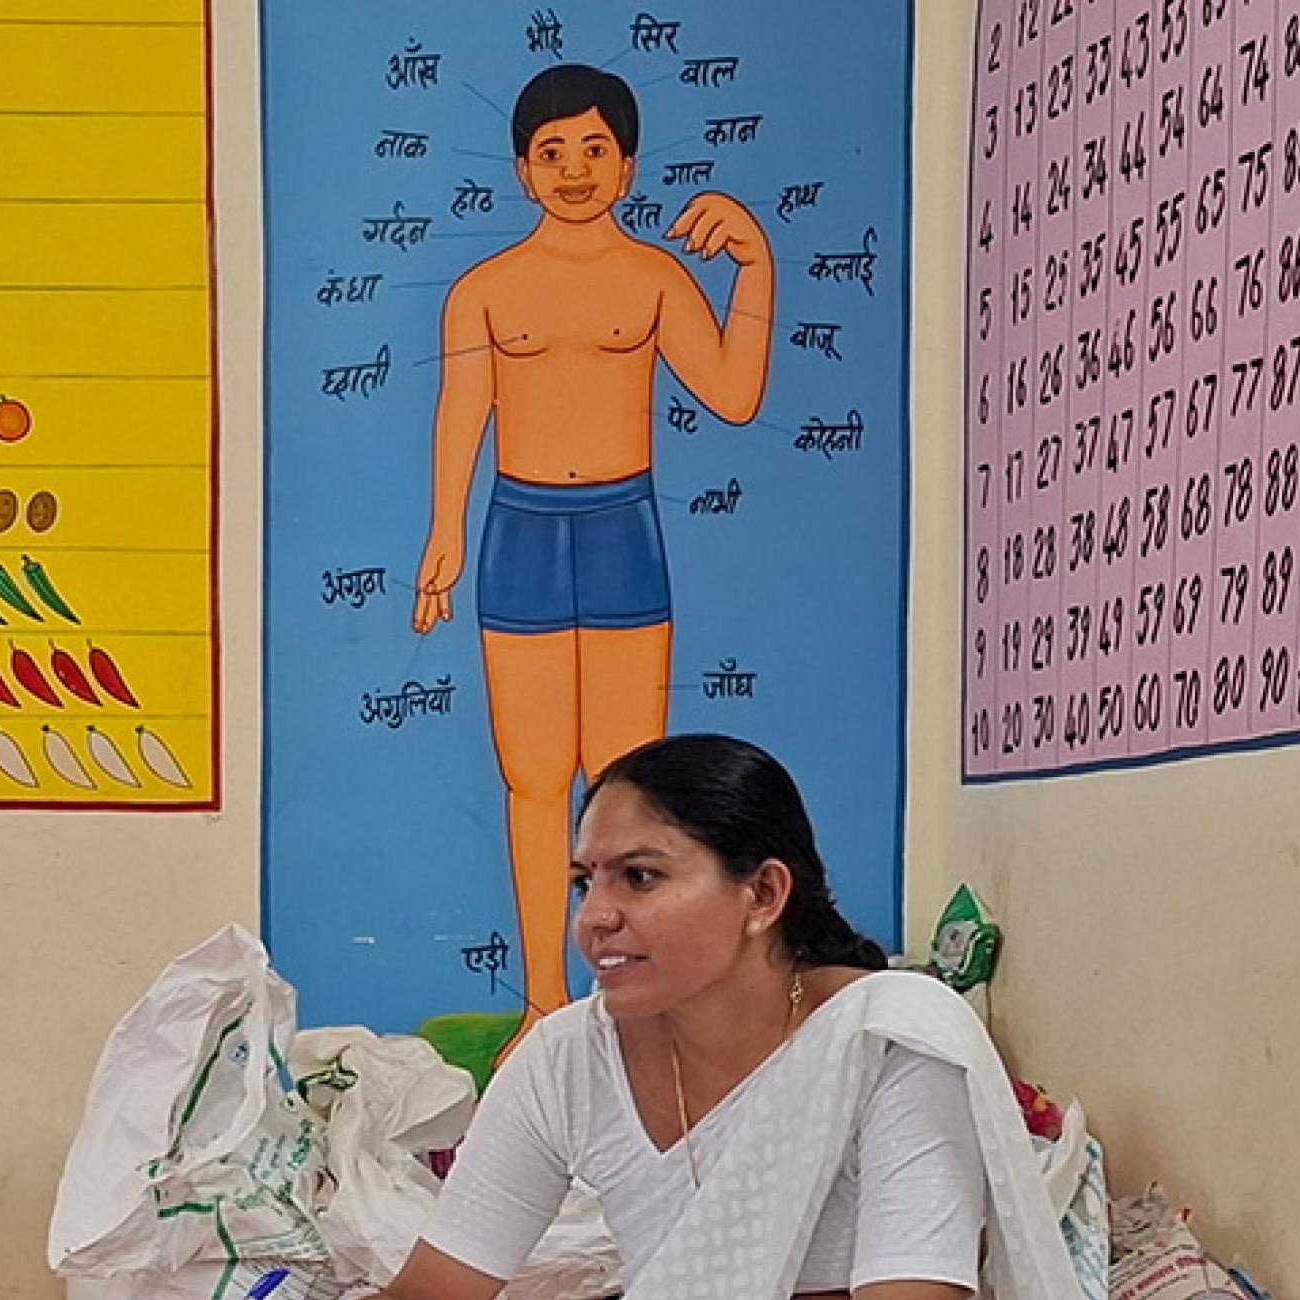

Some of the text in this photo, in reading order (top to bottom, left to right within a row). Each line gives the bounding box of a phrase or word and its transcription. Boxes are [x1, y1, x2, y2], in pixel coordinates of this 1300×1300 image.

[630, 13, 681, 54] सिर
[988, 22, 1000, 73] 2
[1017, 0, 1038, 47] 12
[386, 37, 441, 90] आँख
[680, 57, 739, 87] बाल
[984, 105, 998, 160] 3
[1015, 81, 1037, 137] 13
[1048, 55, 1073, 119] 23
[1085, 35, 1111, 104] 33
[1121, 12, 1149, 88] 43
[374, 130, 429, 158] नाक
[704, 114, 763, 148] कान
[979, 200, 994, 252] 4
[1013, 182, 1032, 235] 14
[1047, 155, 1071, 215] 24
[1083, 137, 1107, 199] 34
[1120, 111, 1146, 183] 44
[1160, 85, 1185, 157] 54
[1199, 64, 1223, 128] 64
[1239, 34, 1269, 106] 74
[662, 160, 714, 185] गाल
[363, 200, 432, 252] गर्दन
[621, 190, 663, 233] दाँत
[777, 181, 824, 223] हाथ
[808, 226, 877, 296] कलाई
[980, 288, 992, 340] 5
[1012, 268, 1032, 326] 15
[1045, 250, 1069, 310] 25
[1081, 233, 1106, 297] 35
[1116, 217, 1143, 286] 45
[1154, 192, 1185, 267] 55
[1196, 168, 1225, 234] 65
[1238, 142, 1272, 213] 75
[317, 268, 383, 307] कंधा
[979, 375, 989, 424] 6
[1008, 357, 1027, 415] 16
[1040, 345, 1064, 405] 26
[1076, 328, 1100, 389] 36
[1108, 310, 1135, 378] 46
[1149, 291, 1174, 362] 56
[1192, 276, 1217, 342] 66
[1235, 248, 1263, 318] 76
[322, 343, 390, 401] छाती
[667, 395, 698, 434] पेट
[793, 408, 864, 460] कोहनी
[978, 464, 992, 508] 7
[1006, 451, 1023, 504] 17
[1037, 435, 1062, 490] 27
[1074, 416, 1100, 475] 37
[1107, 409, 1133, 473] 47
[1146, 389, 1174, 459] 57
[1187, 374, 1217, 438] 67
[1232, 358, 1263, 417] 77
[977, 443, 1298, 604] 8 18 28 38 48 58 68 78 88
[975, 545, 1293, 679] 9 19 29 39 49 59 69 79 89
[972, 646, 1289, 757] 10 20 30 40 50 60 70 80 90
